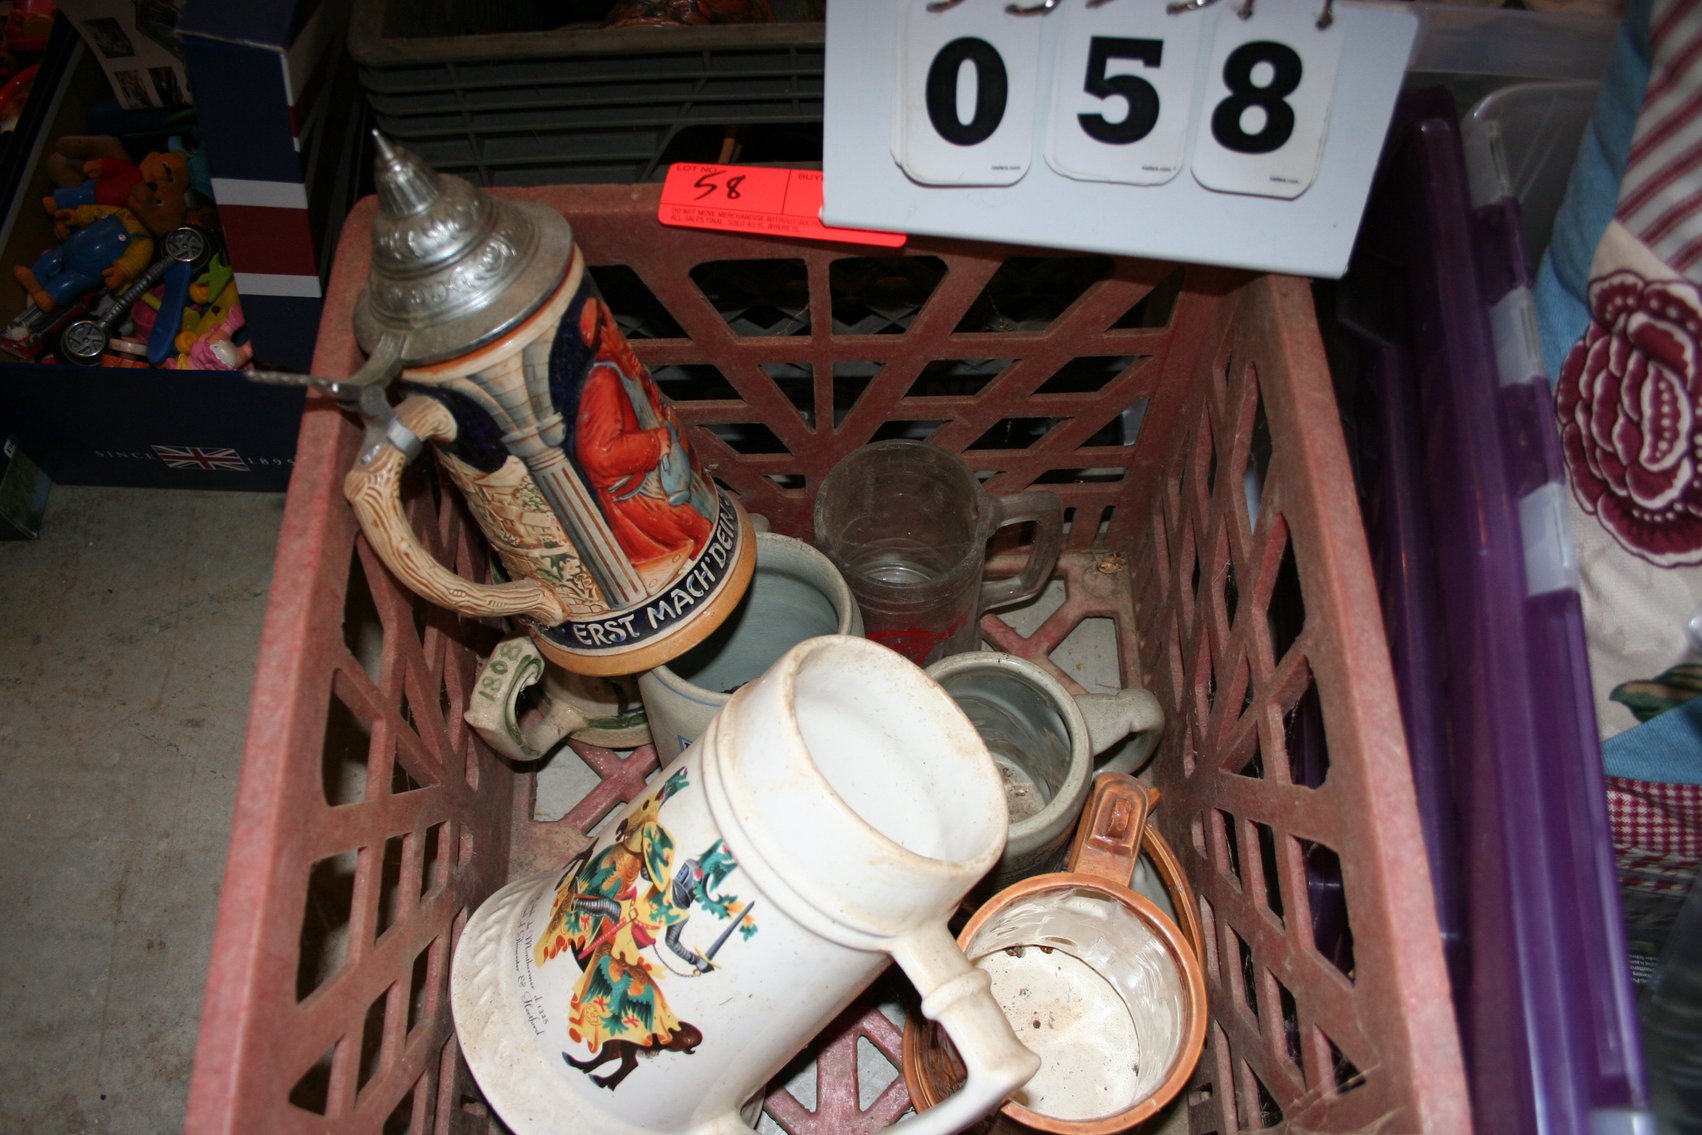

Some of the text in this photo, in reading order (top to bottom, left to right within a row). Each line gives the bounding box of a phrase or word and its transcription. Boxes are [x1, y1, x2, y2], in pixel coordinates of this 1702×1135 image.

[676, 164, 698, 172] LOT
[693, 170, 746, 200] 58
[573, 614, 640, 646] ERST
